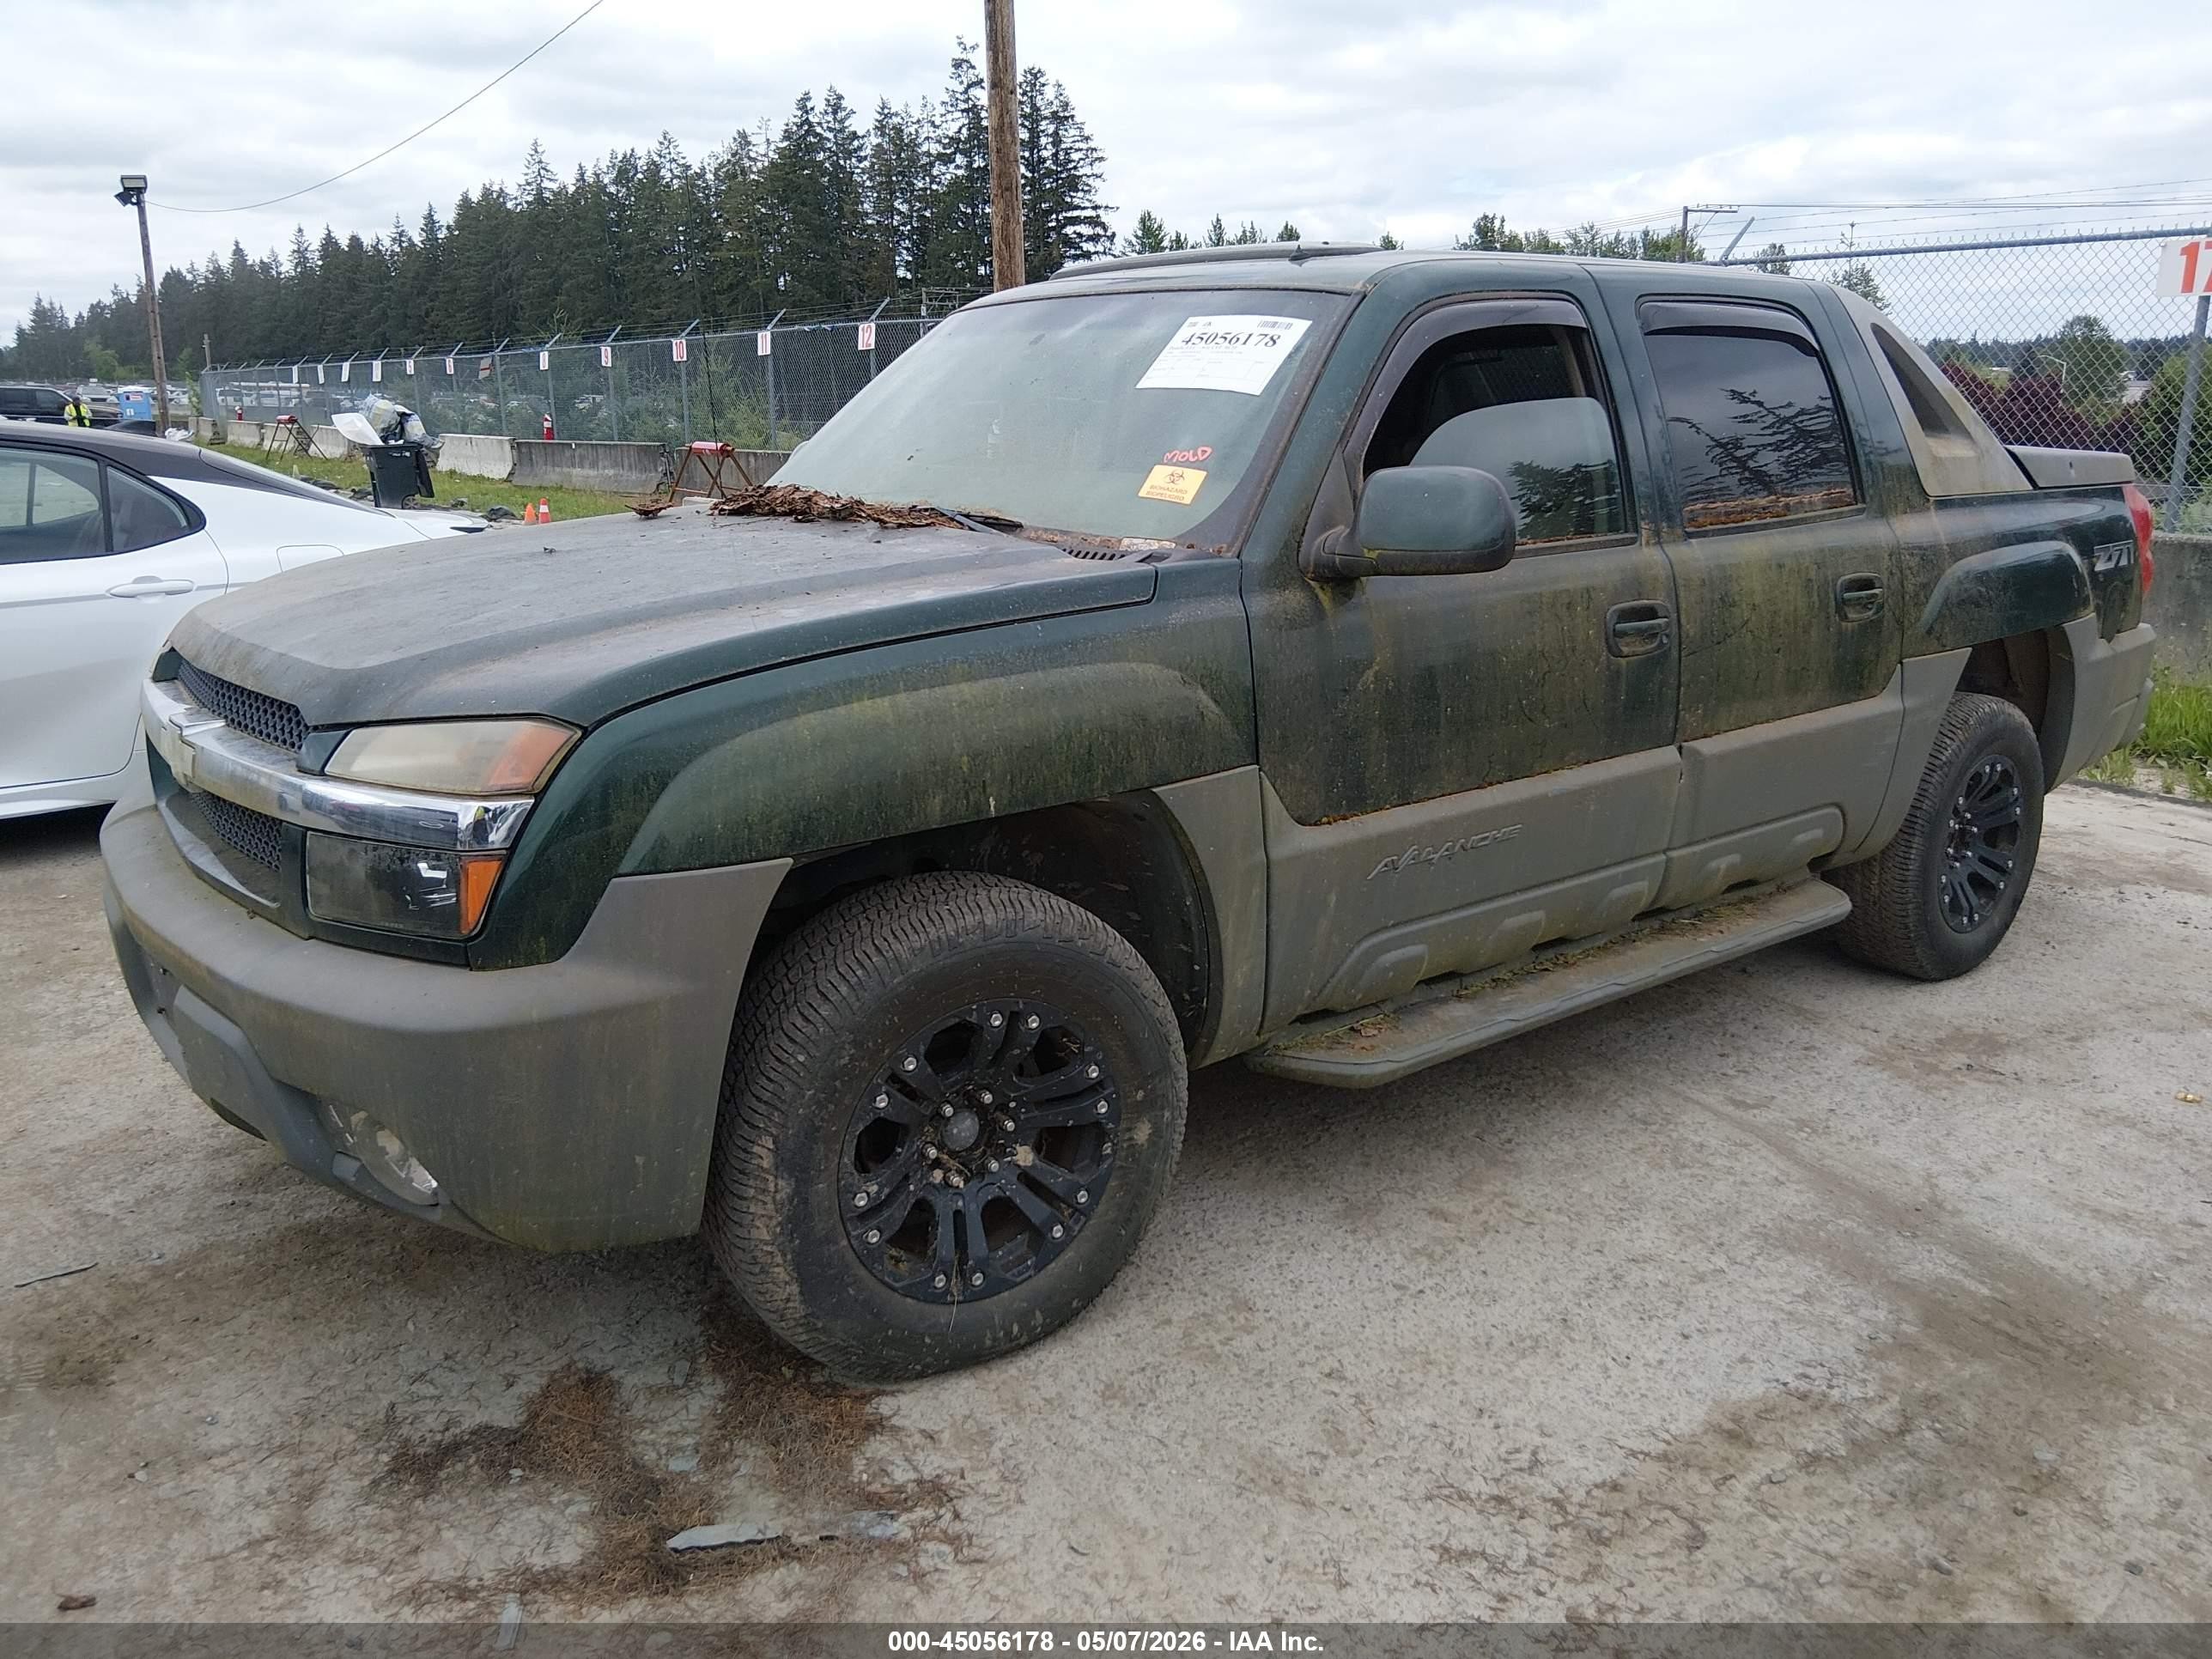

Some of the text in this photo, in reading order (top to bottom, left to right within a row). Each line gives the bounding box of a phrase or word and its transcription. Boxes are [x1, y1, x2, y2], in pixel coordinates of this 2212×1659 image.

[761, 333, 769, 354] 11
[861, 324, 872, 349] 12
[1182, 331, 1282, 348] 45056178
[604, 349, 609, 365] 9
[674, 340, 684, 359] 10
[1164, 446, 1213, 463] MOLD
[2094, 539, 2134, 571] Z71
[1366, 823, 1523, 880] AVALANCHE
